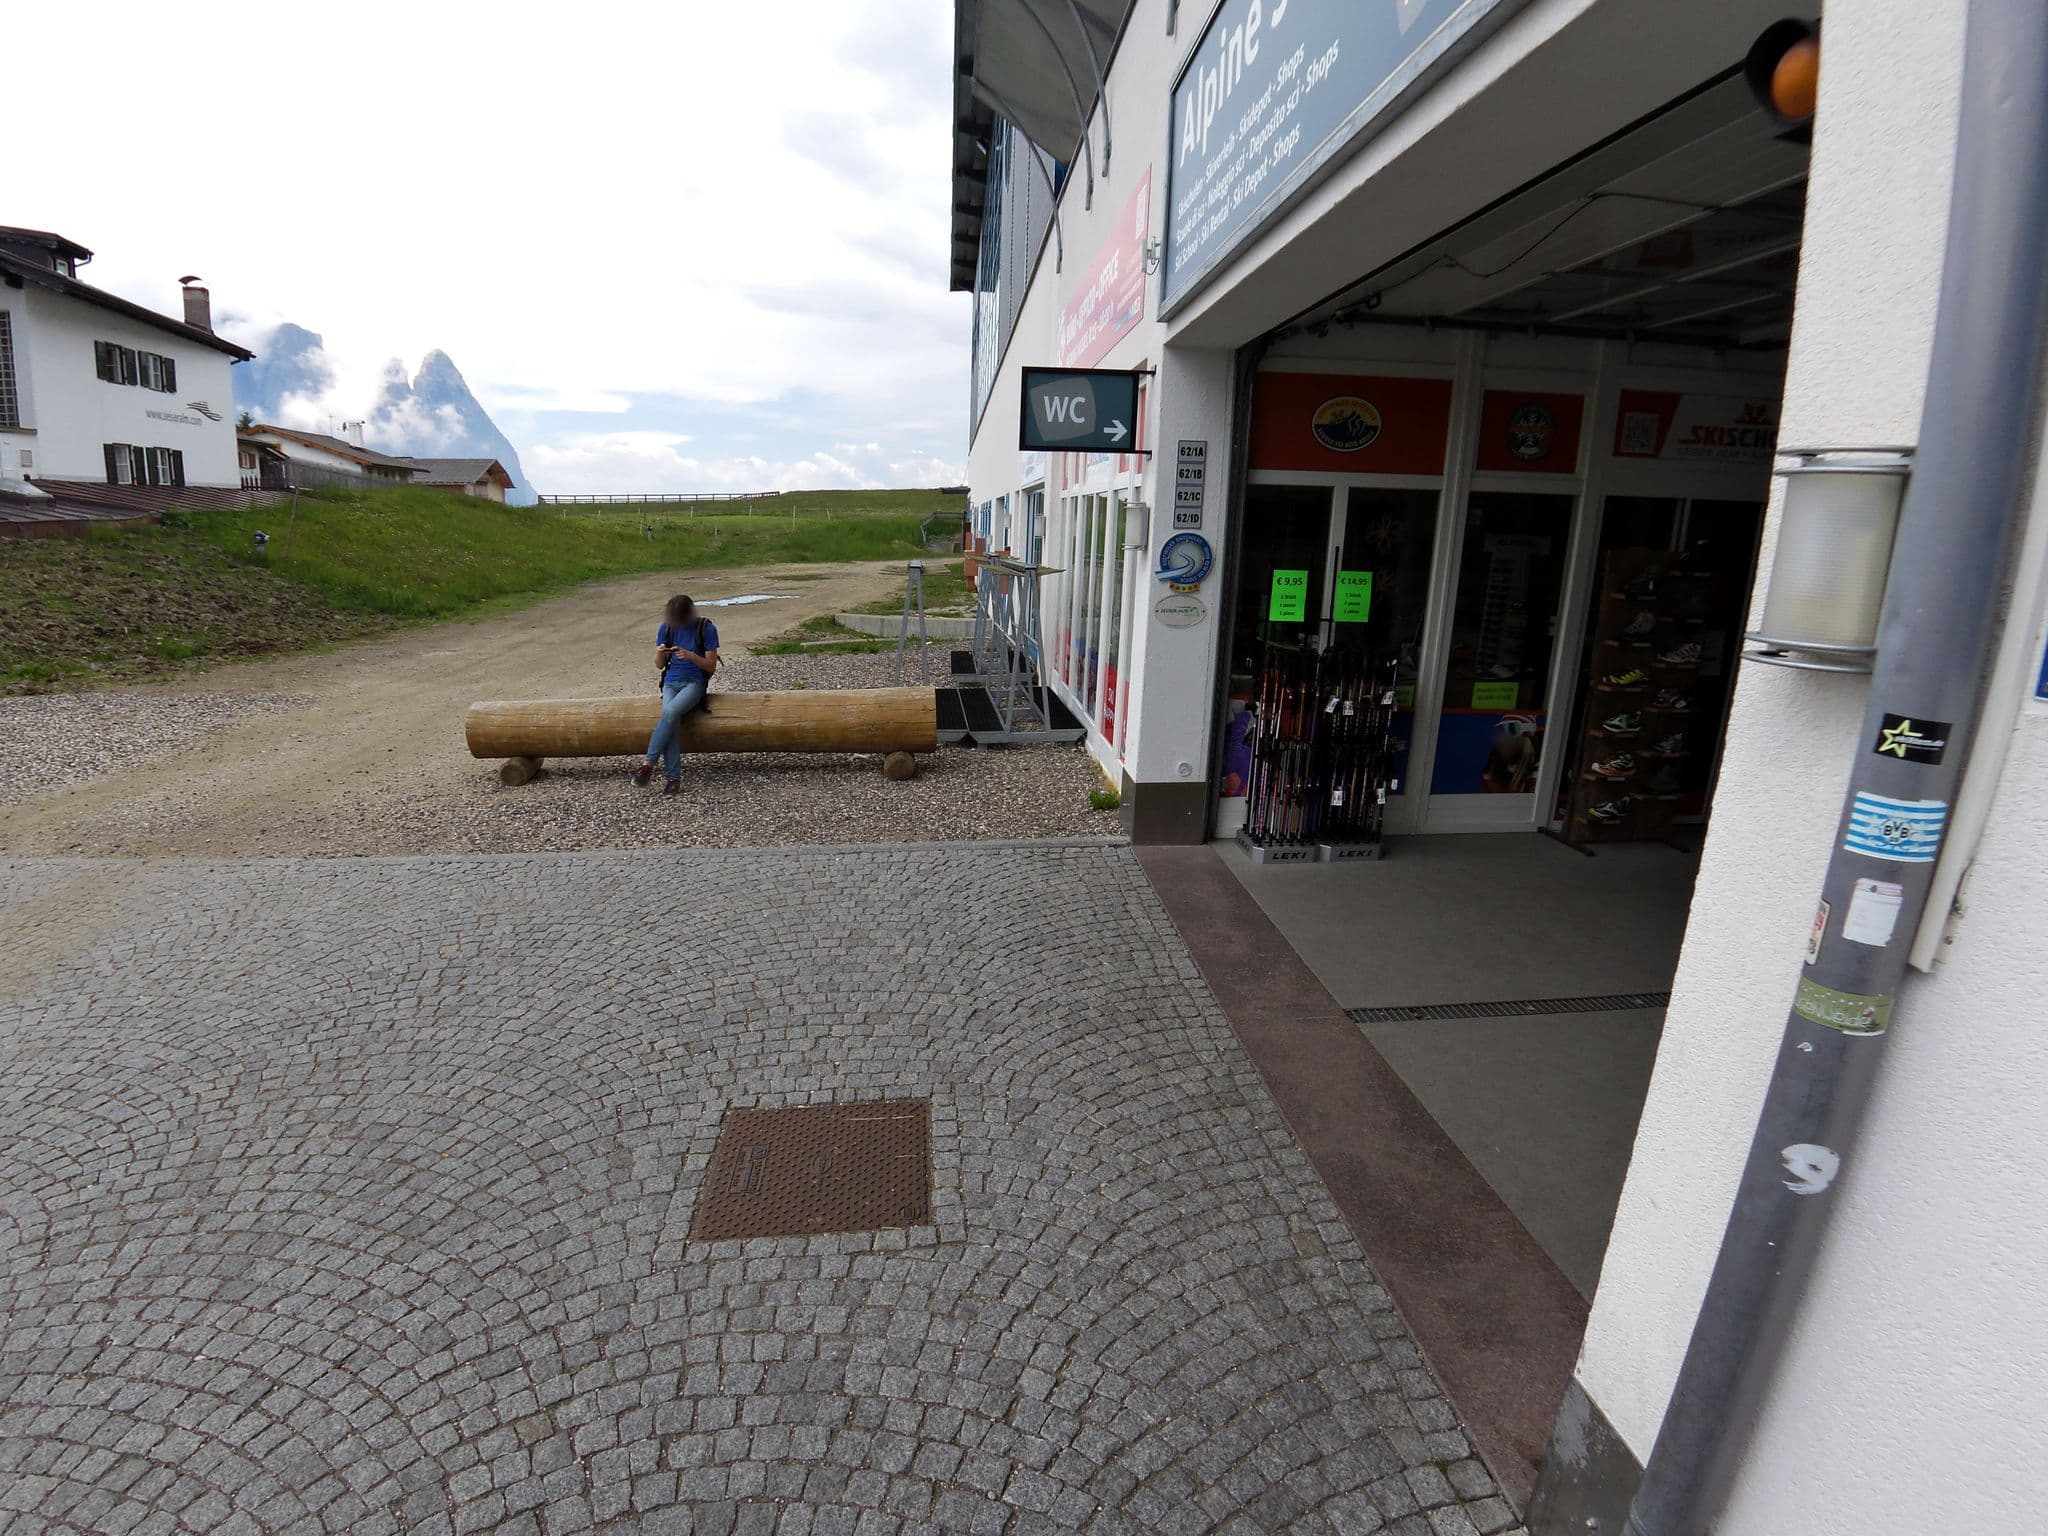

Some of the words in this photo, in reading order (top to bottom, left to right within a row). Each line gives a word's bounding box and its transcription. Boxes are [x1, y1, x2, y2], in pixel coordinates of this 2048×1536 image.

[1180, 0, 1263, 169] Alpine
[1239, 81, 1271, 140] Skidepot
[1277, 42, 1304, 92] Shops
[1235, 146, 1246, 177] sci
[1249, 104, 1286, 160] Deposito
[1286, 79, 1300, 116] sci
[1306, 39, 1339, 93] Shops
[1210, 194, 1230, 236] Rental
[1233, 180, 1244, 210] Ski
[1244, 155, 1268, 198] Depot
[1273, 122, 1300, 167] Shops
[1043, 395, 1086, 424] WC
[1180, 445, 1204, 457] 62/1A
[1178, 468, 1203, 480] 62/1B
[1177, 490, 1201, 502] 62/1C
[1176, 512, 1200, 524] 62/1D
[1284, 577, 1303, 587] 9,95
[1347, 578, 1368, 586] 14,95
[1883, 821, 1910, 839] BVB
[1272, 852, 1306, 860] LEKI
[1339, 850, 1372, 858] LEKI
